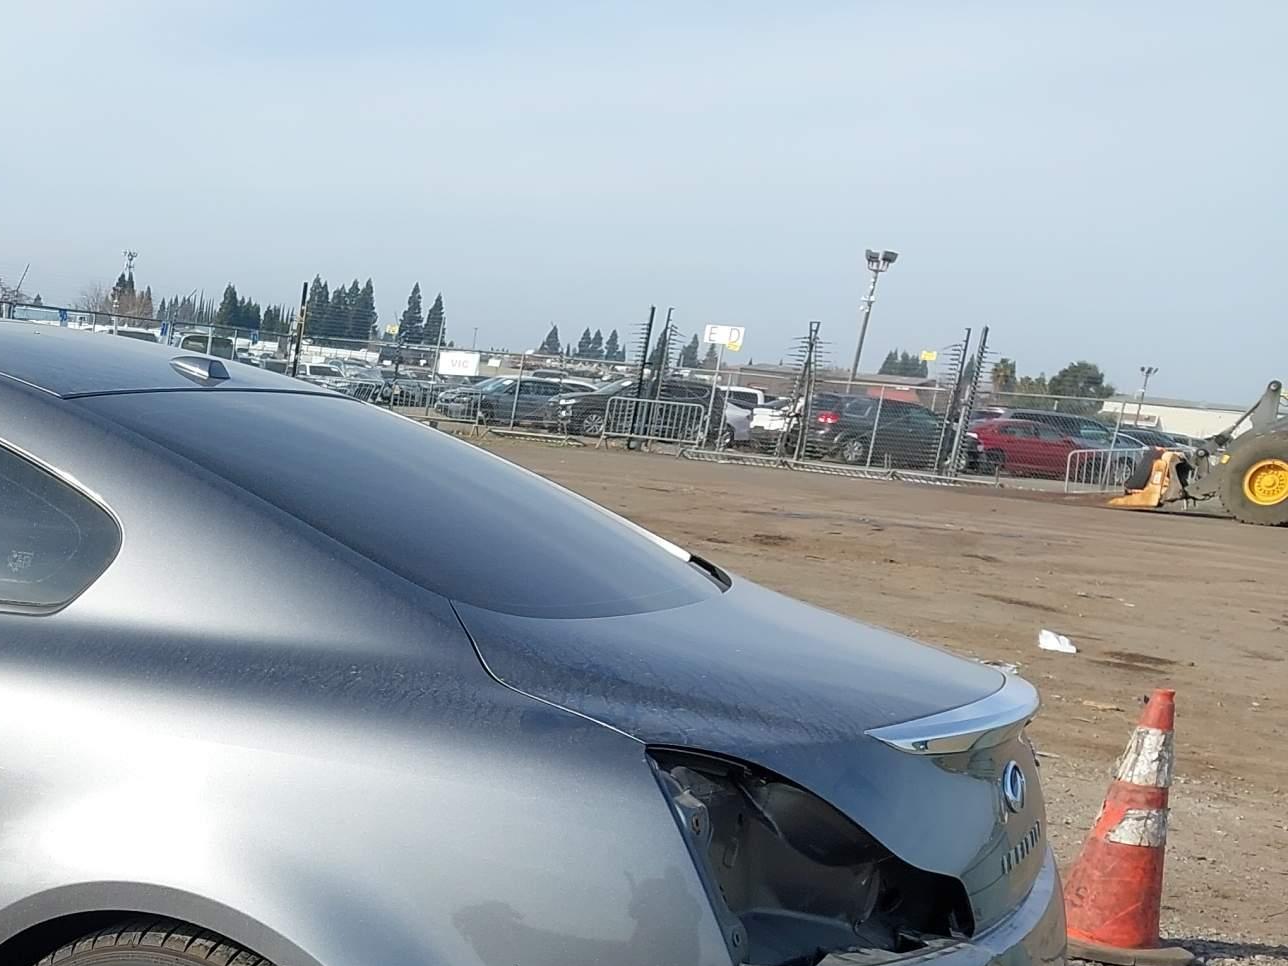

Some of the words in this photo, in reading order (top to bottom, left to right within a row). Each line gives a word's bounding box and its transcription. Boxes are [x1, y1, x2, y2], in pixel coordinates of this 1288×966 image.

[708, 326, 719, 342] E
[728, 327, 741, 343] D
[450, 358, 470, 369] VIC
